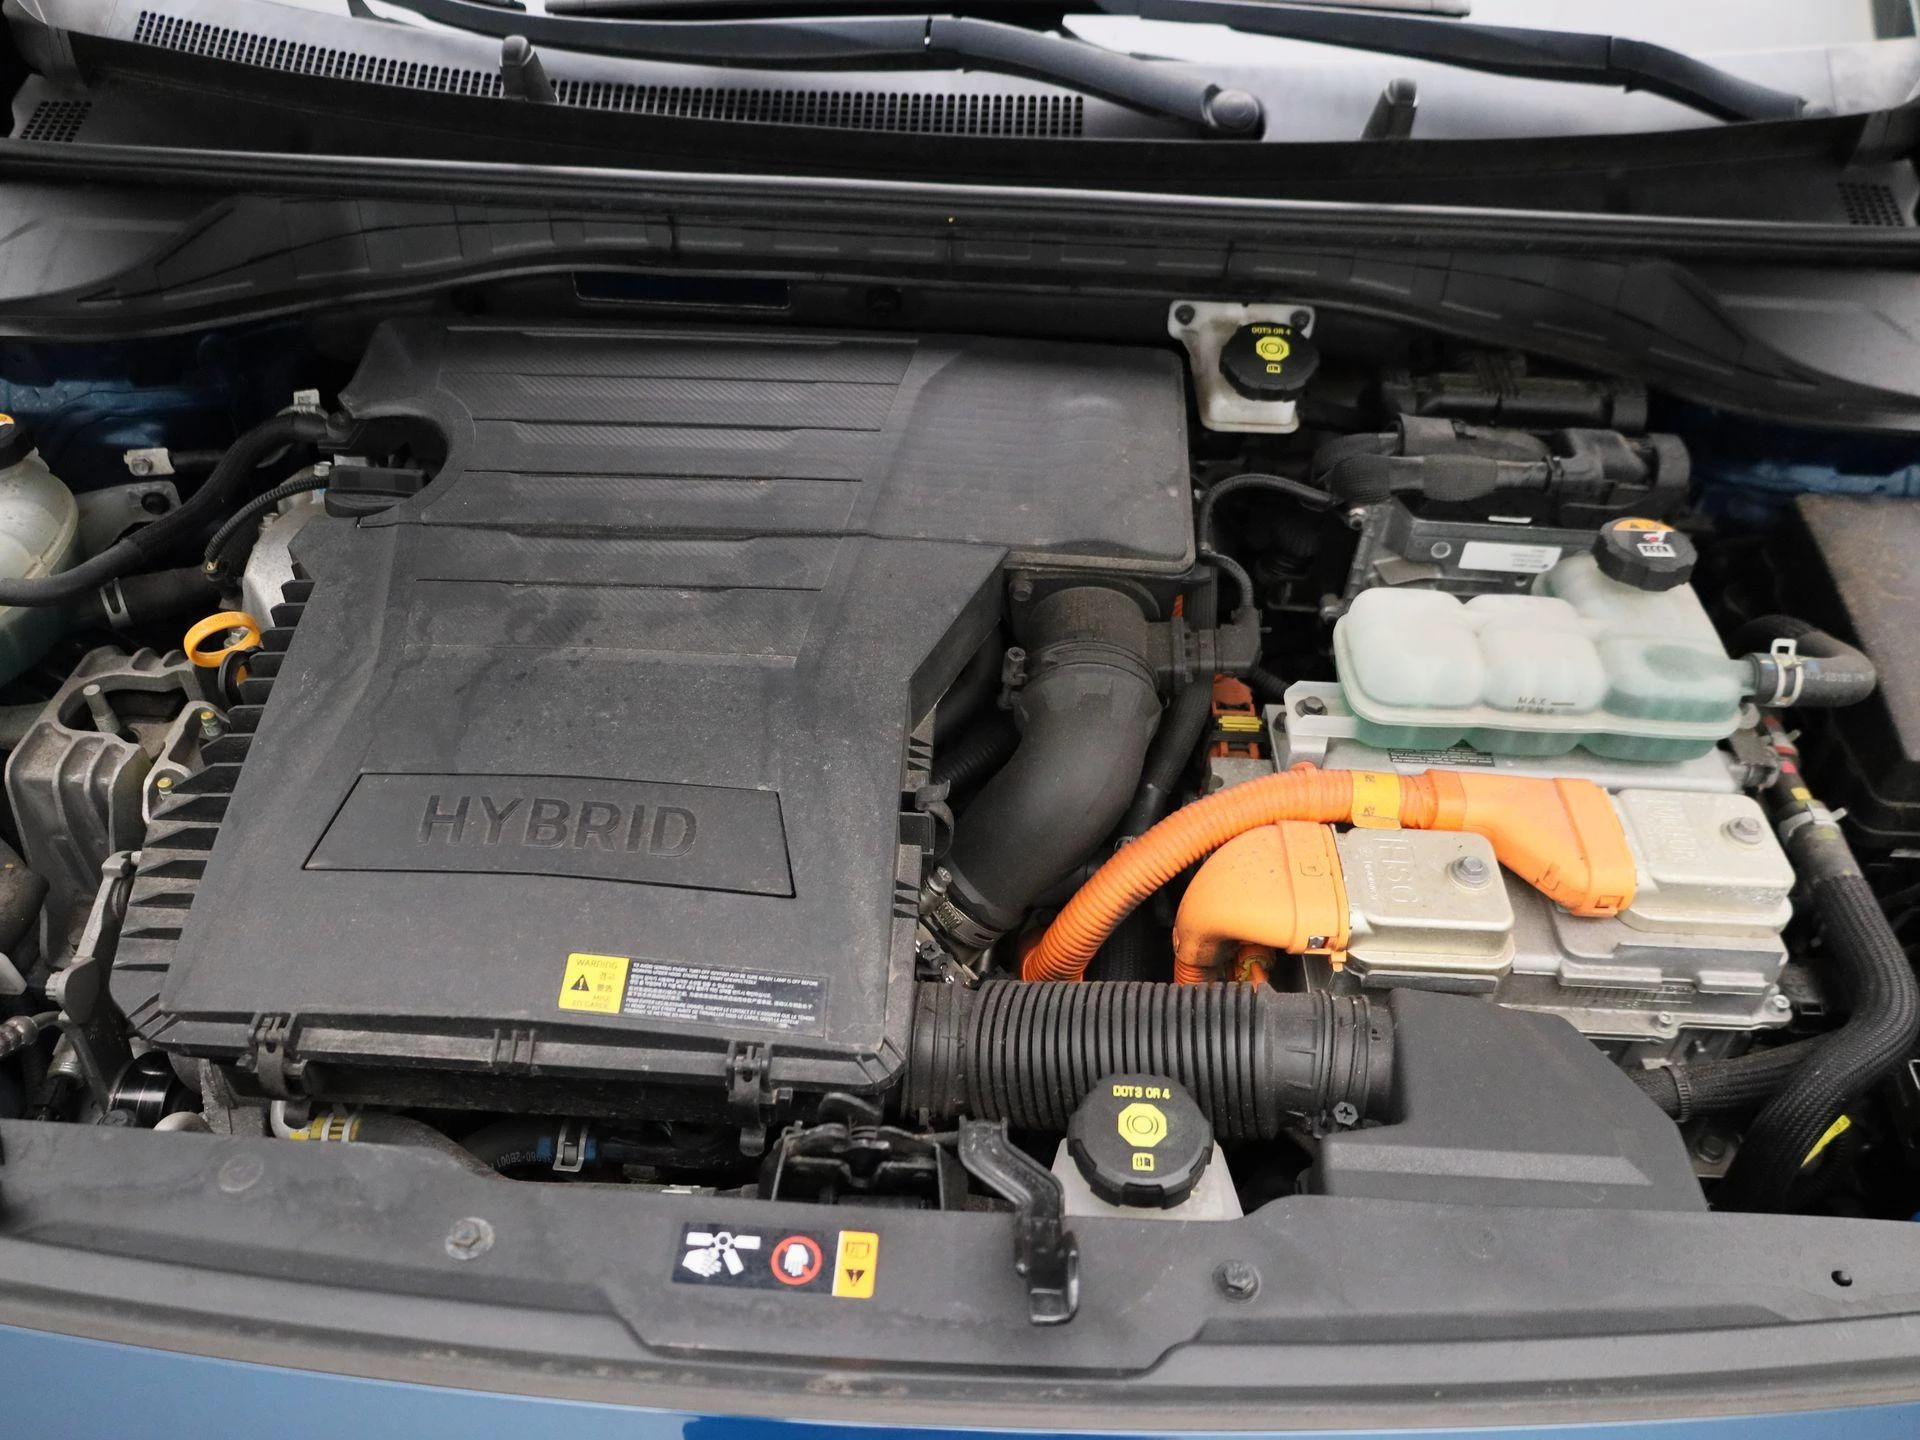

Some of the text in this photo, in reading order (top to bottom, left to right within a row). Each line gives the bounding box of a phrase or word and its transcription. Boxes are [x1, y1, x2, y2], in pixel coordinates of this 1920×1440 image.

[418, 794, 698, 858] HYBRID
[577, 960, 618, 969] WARNING
[1112, 1085, 1171, 1100] DOT3 OR 4
